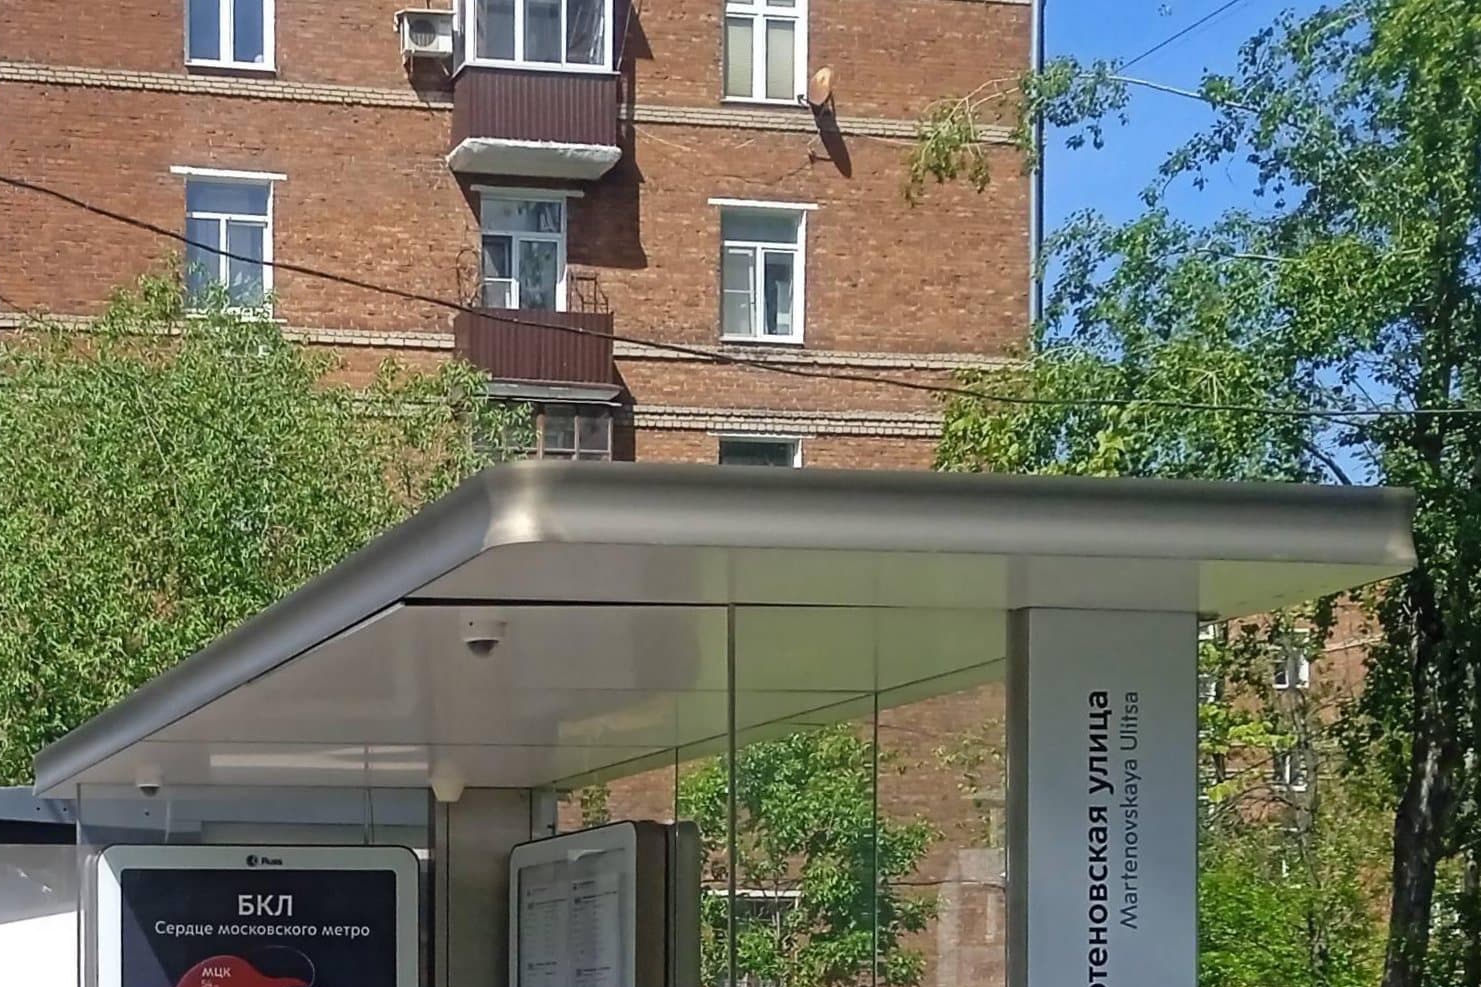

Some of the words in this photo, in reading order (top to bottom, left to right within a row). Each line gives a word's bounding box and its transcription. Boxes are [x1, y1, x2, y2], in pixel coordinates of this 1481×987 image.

[1120, 690, 1139, 751] Ulitsa
[1087, 690, 1114, 795] улица
[1120, 758, 1142, 930] Martenovskaya
[238, 894, 293, 917] БКЛ
[154, 920, 214, 937] Сердце
[218, 924, 318, 937] московского
[321, 925, 371, 940] метро
[201, 966, 232, 979] МЦК
